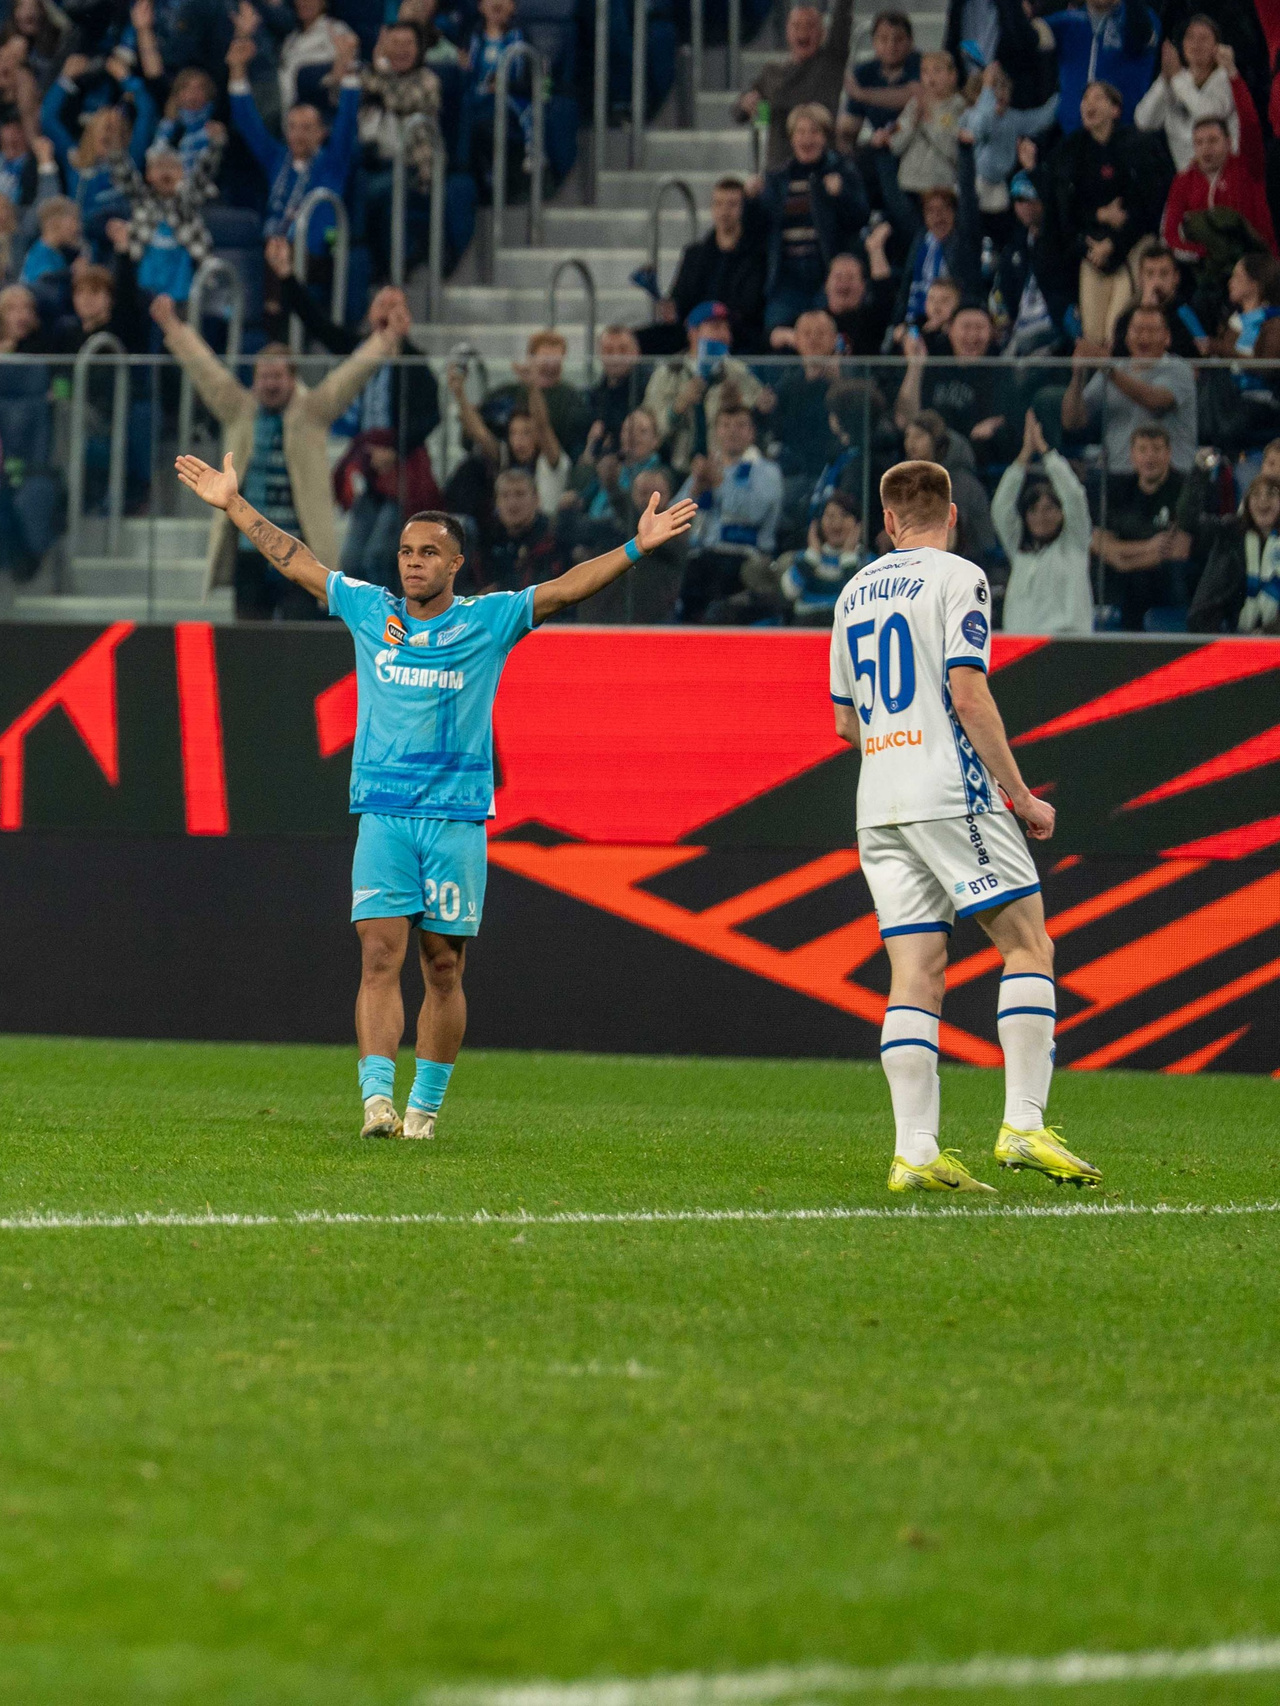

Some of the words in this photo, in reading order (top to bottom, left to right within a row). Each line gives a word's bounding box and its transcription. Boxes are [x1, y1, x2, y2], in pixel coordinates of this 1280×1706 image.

[843, 576, 925, 618] КУТИЦКИЙ
[394, 665, 464, 690] ГАЗПРОМ
[846, 611, 916, 725] 50
[423, 878, 460, 921] 20
[967, 873, 998, 895] ВТБ
